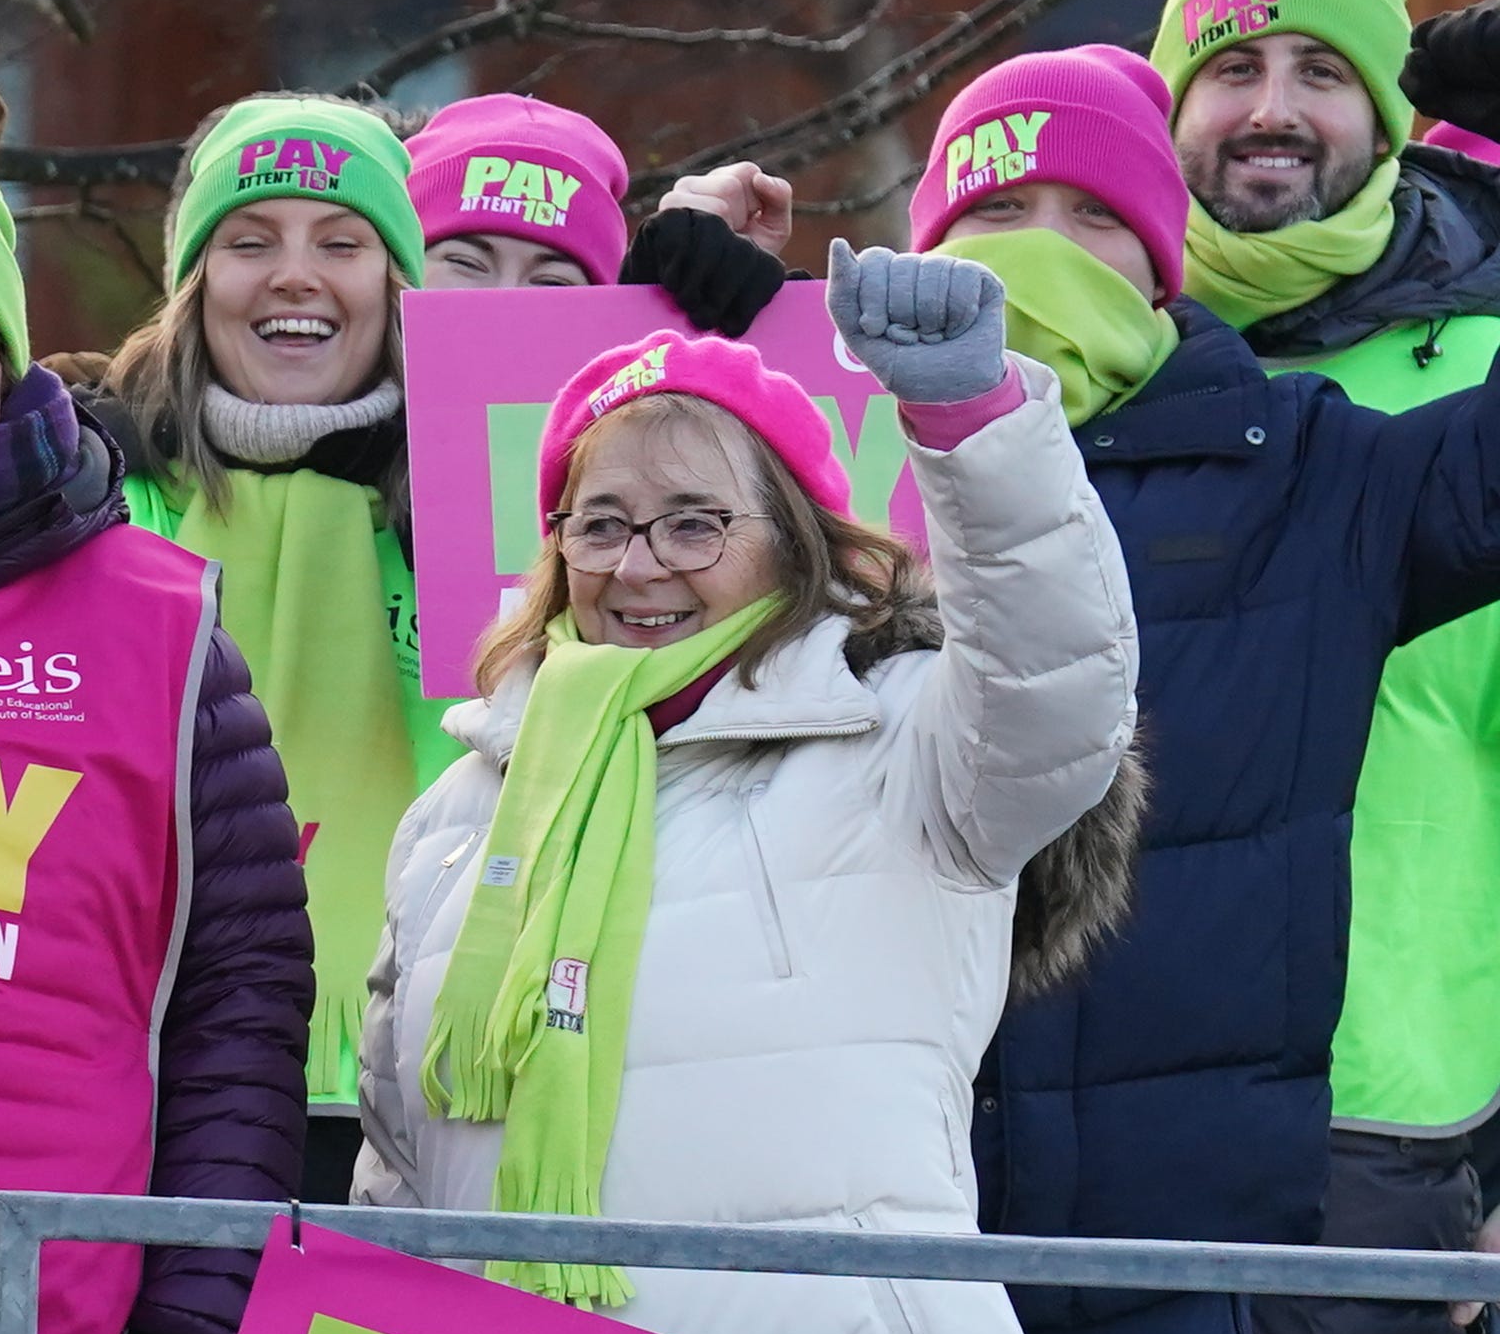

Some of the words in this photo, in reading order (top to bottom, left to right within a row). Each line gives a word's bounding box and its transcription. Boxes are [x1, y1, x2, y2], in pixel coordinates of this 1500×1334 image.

[238, 138, 352, 177] PAY
[946, 111, 1051, 188] PAY
[460, 156, 582, 212] PAY
[6, 697, 73, 711] Educational
[20, 709, 32, 720] of
[34, 711, 85, 722] Scotland
